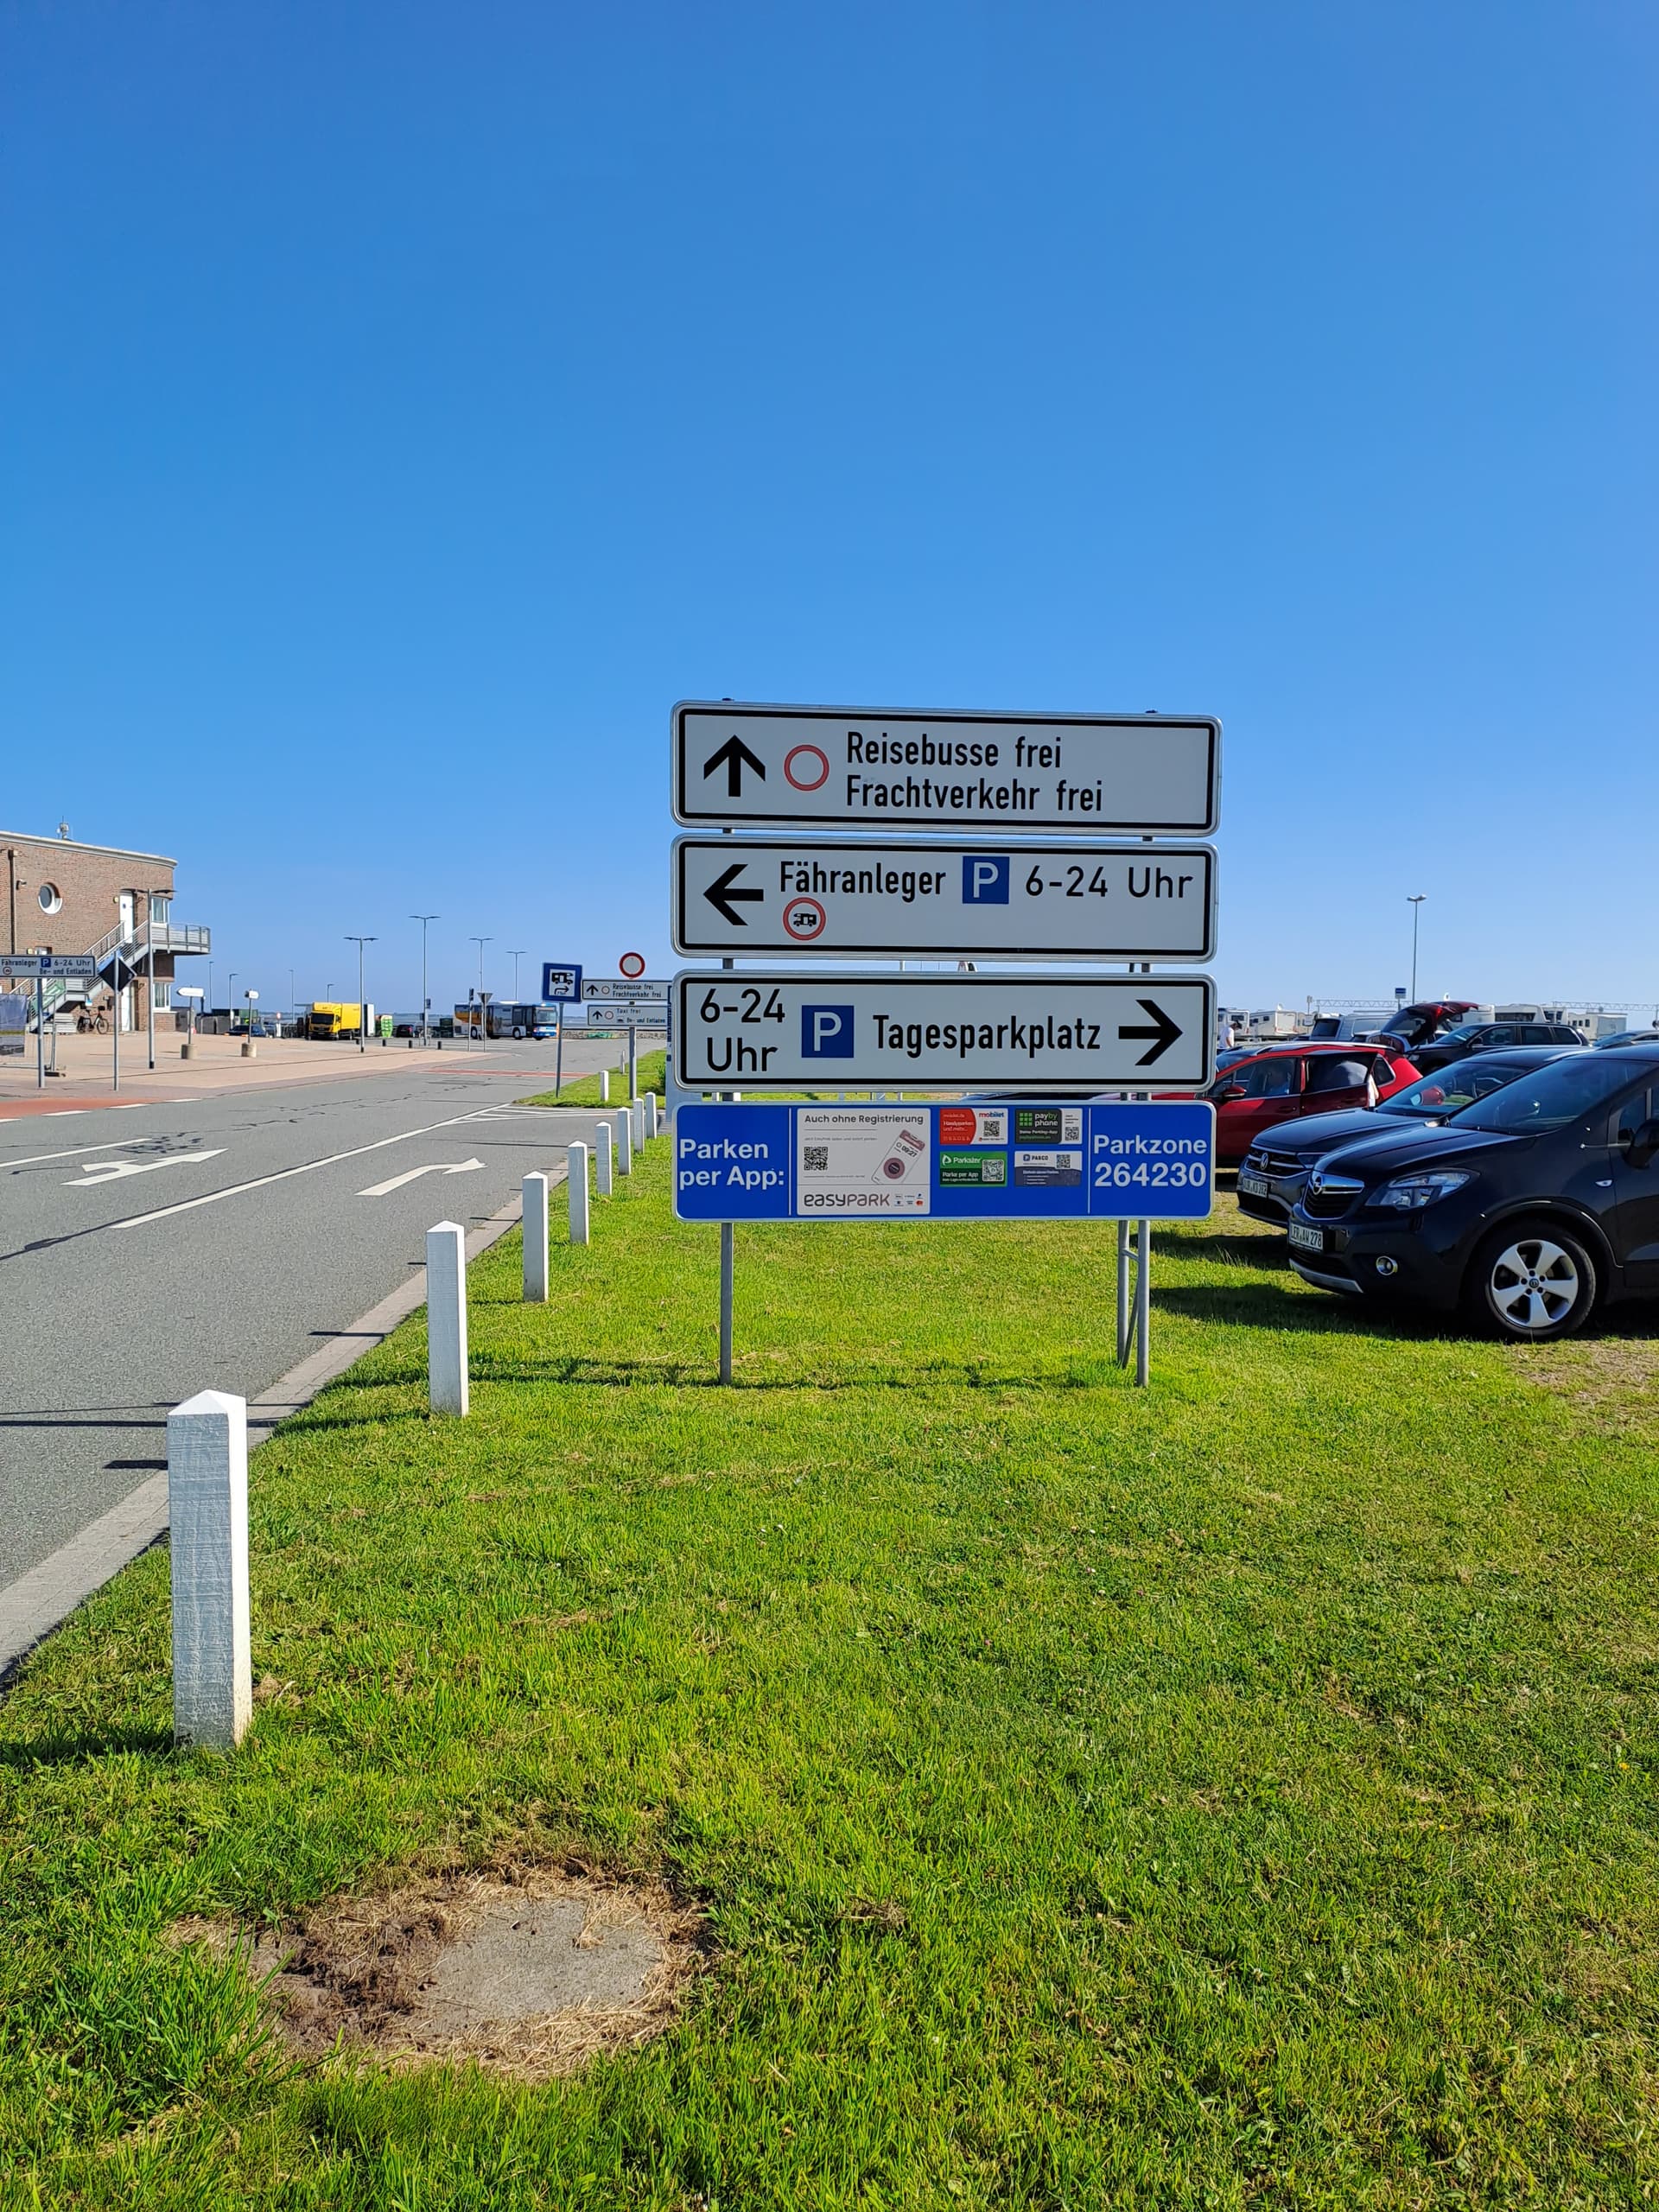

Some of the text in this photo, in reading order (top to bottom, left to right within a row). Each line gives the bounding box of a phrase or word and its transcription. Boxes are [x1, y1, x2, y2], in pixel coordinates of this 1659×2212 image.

[847, 731, 1062, 768] Reisebusse frei
[847, 774, 1103, 811] Frachtverkehr frei
[780, 861, 1194, 901] Fähranleger P 6-24 Uhr
[700, 988, 785, 1024] 6-24
[813, 1011, 1101, 1058] P Tagesparkplatz
[707, 1037, 779, 1072] Uhr
[804, 1114, 924, 1125] Auch ohne Registrierung
[680, 1138, 768, 1159] Parken
[1094, 1135, 1207, 1155] Parkzone
[679, 1165, 785, 1191] per App:
[1094, 1161, 1207, 1188] 264230
